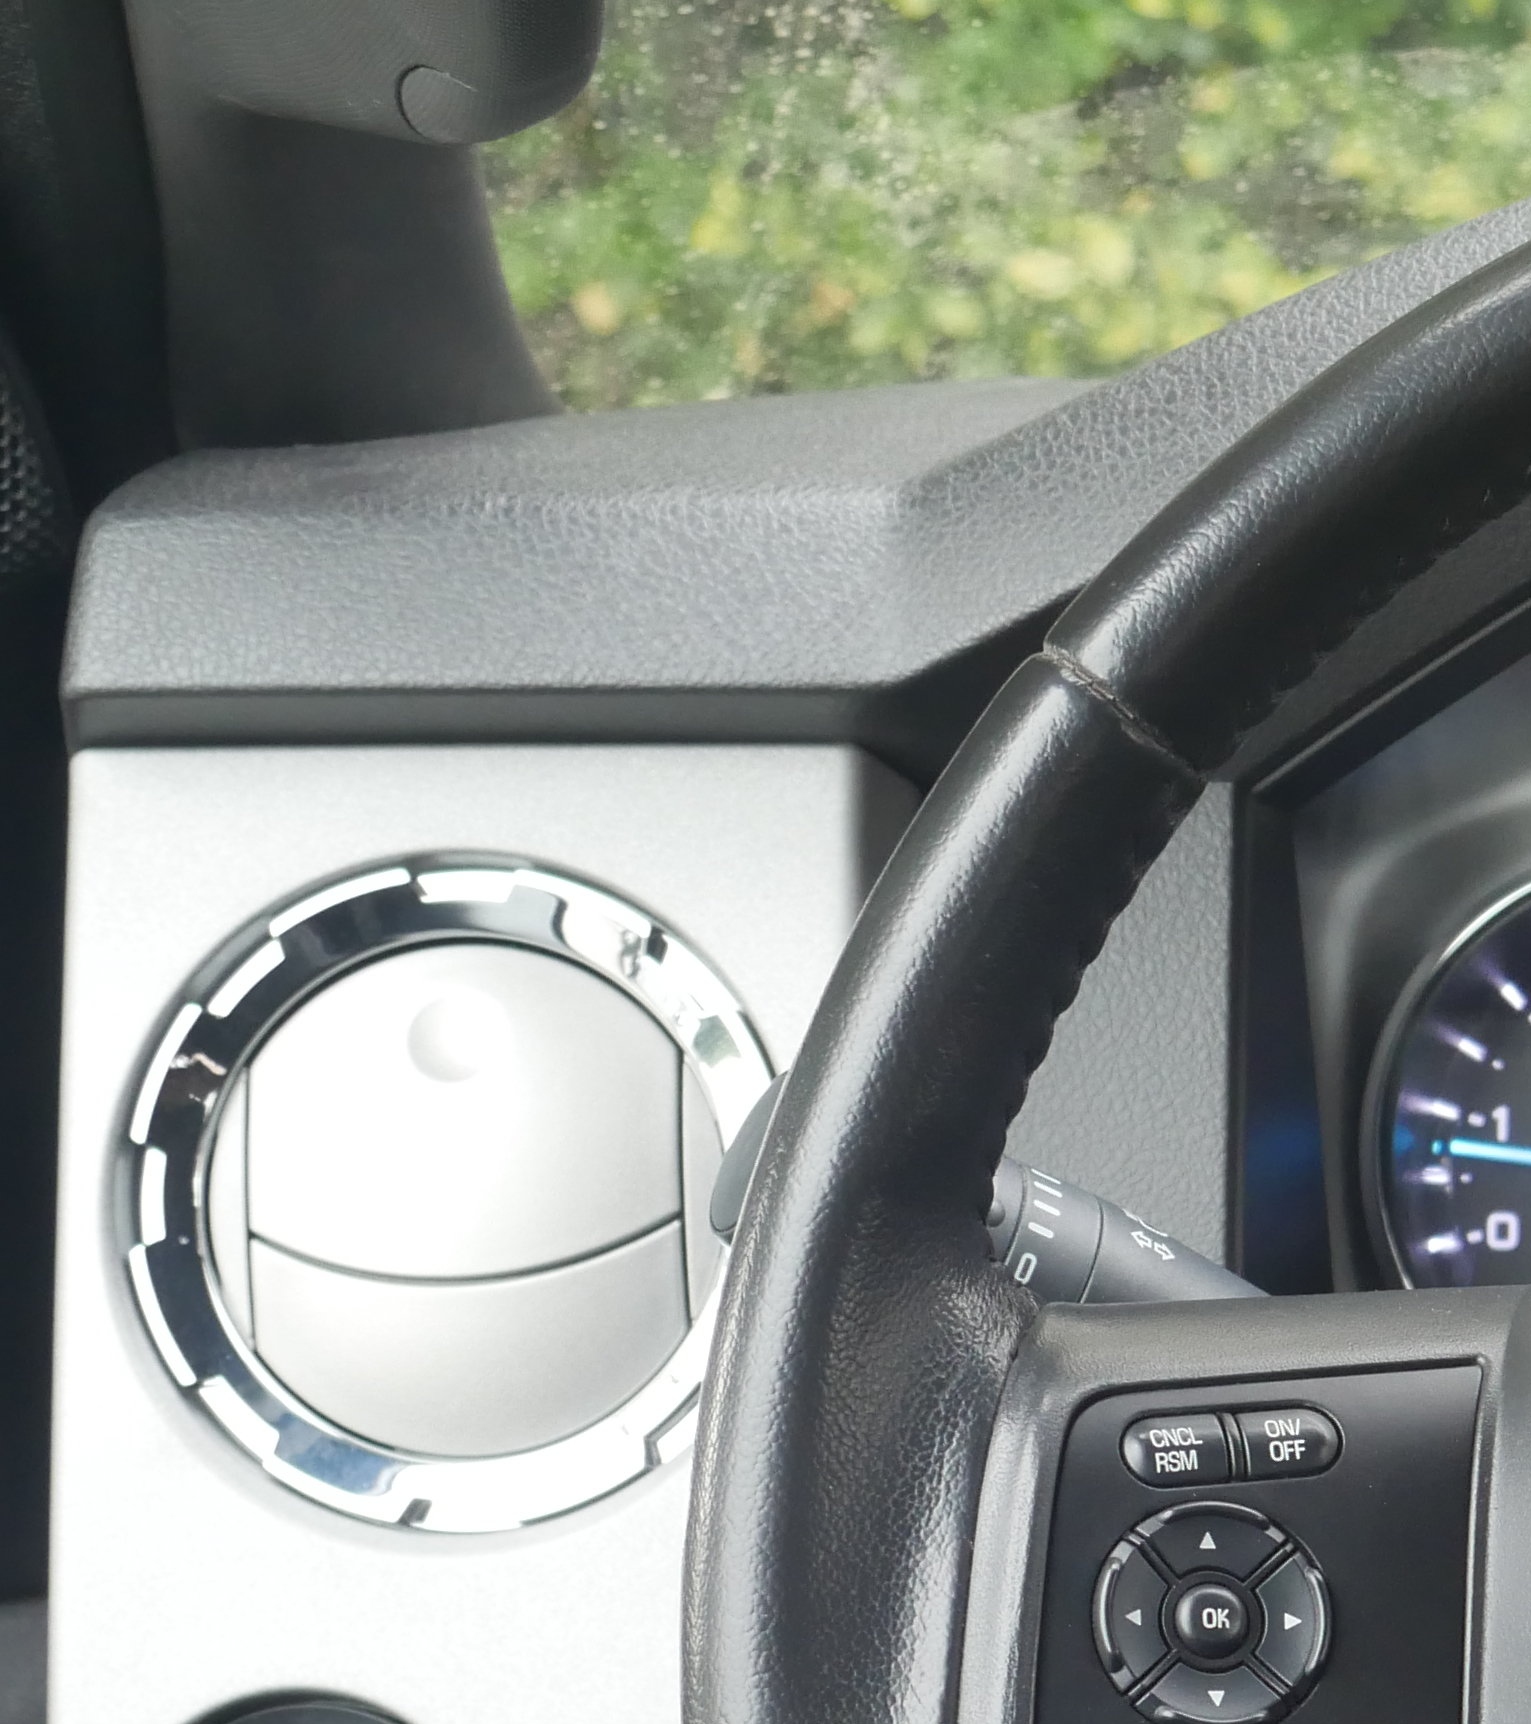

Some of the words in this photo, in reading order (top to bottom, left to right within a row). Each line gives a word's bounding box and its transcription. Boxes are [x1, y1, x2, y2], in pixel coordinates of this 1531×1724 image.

[1491, 1104, 1512, 1143] 1
[1485, 1212, 1521, 1252] 0
[1149, 1427, 1203, 1449] CNCL
[1264, 1418, 1301, 1440] ON/
[1154, 1450, 1199, 1474] RSM
[1269, 1439, 1307, 1463] OFF
[1201, 1607, 1231, 1630] OK
